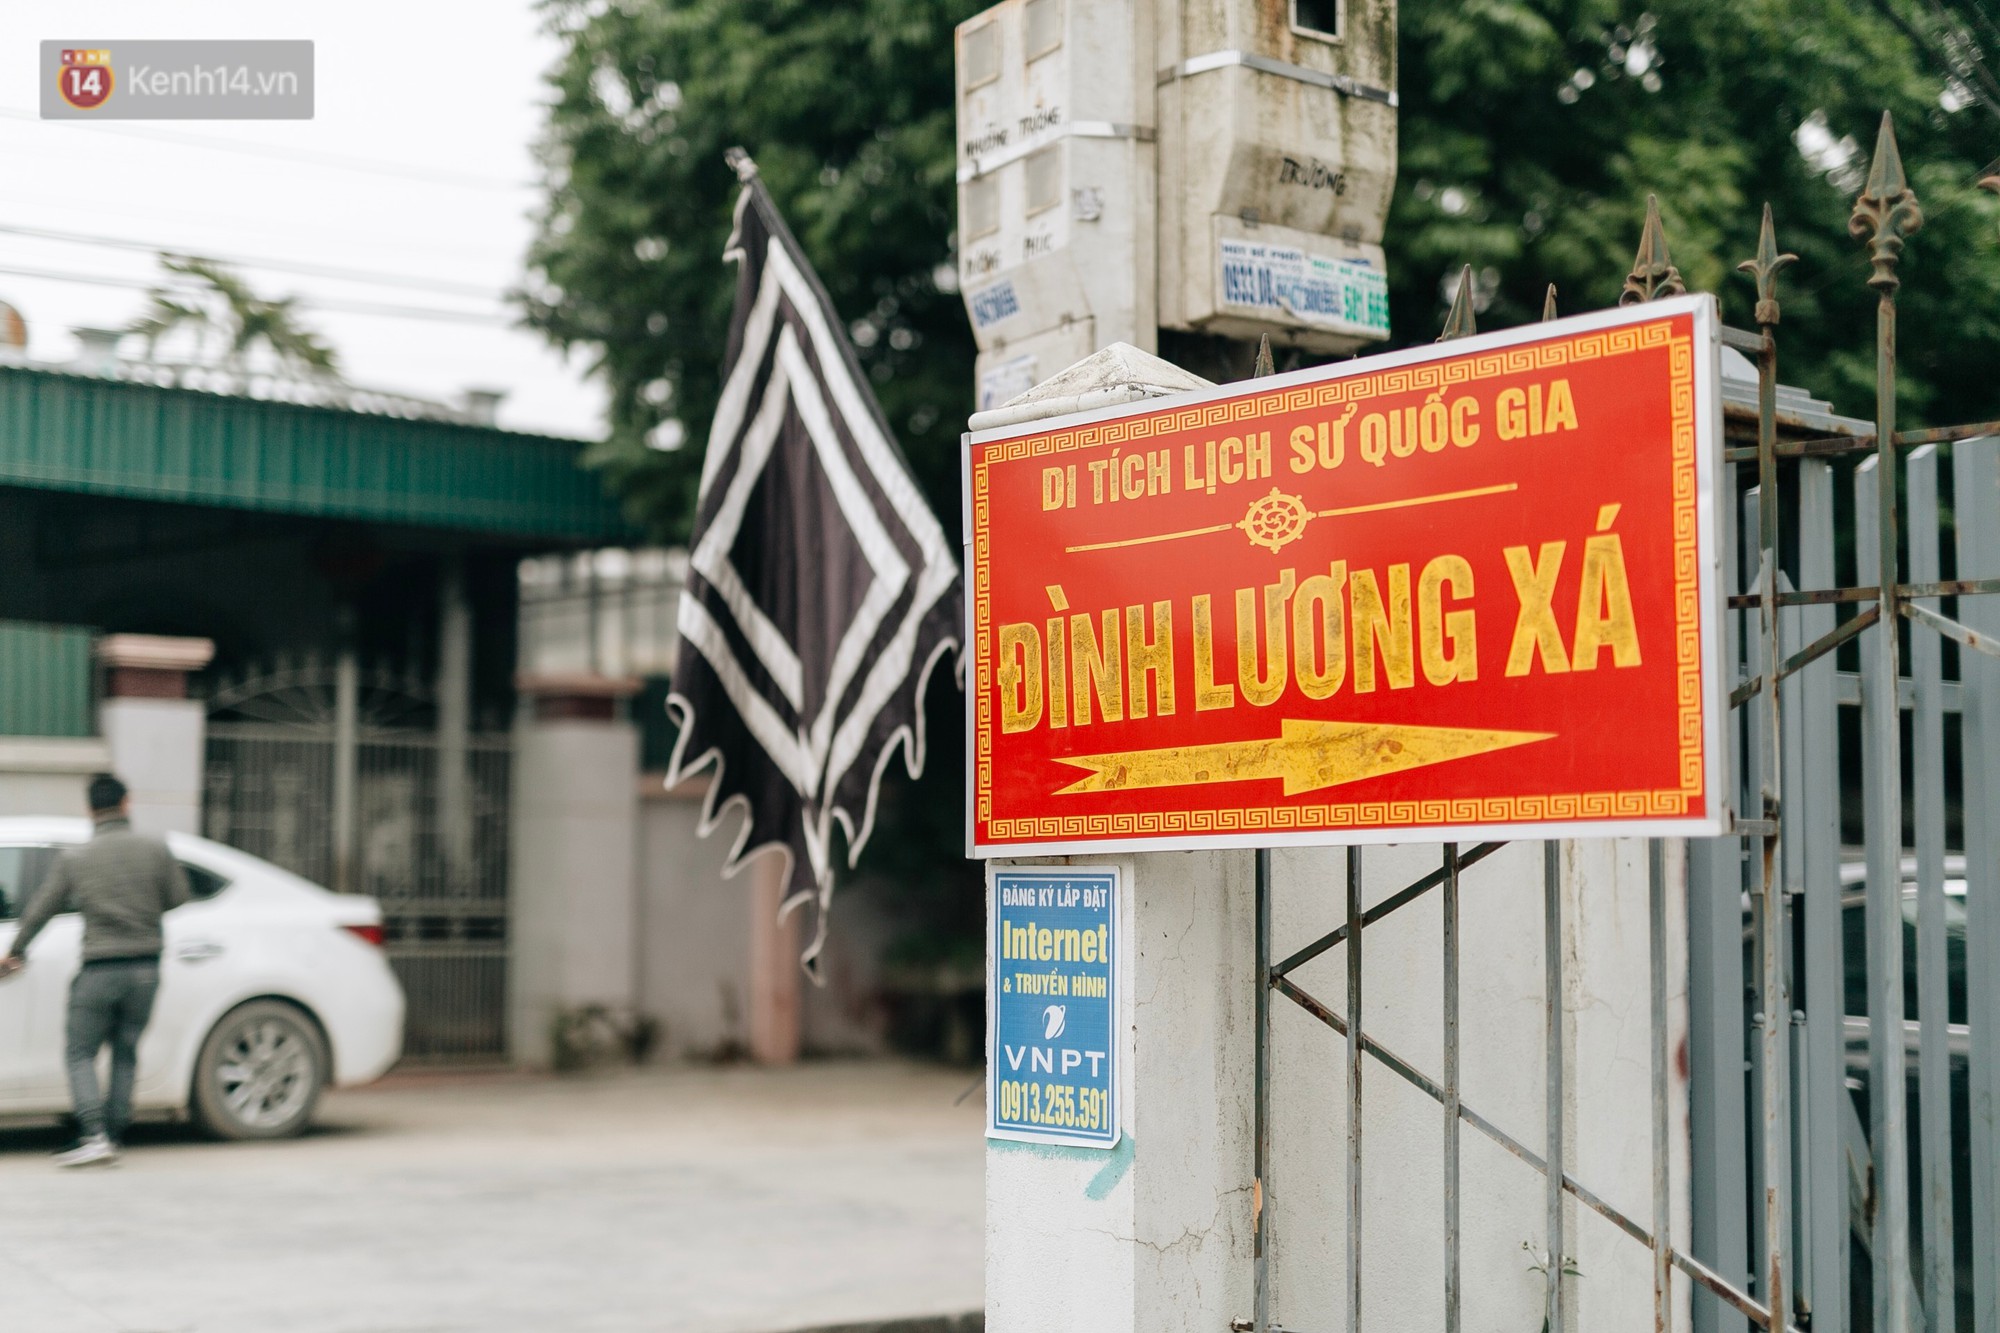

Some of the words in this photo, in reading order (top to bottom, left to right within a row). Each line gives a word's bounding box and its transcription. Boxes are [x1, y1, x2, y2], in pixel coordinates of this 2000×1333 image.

[1042, 465, 1077, 511] DI
[1088, 448, 1171, 505] TÍCH
[1184, 432, 1273, 495] LỊCH
[1289, 402, 1358, 474] SỬ
[1359, 386, 1480, 467] QUỐC
[1496, 379, 1579, 441] GIA
[997, 584, 1175, 734] ĐÌNH
[1192, 554, 1478, 711] LƯƠNG
[1503, 503, 1642, 677] XÁ
[1003, 884, 1036, 906] ĐĂNG
[1038, 884, 1055, 907] KÝ
[1057, 883, 1081, 907] LẮP
[1083, 885, 1107, 912] ĐẶT
[1003, 920, 1108, 964] Internet
[1003, 977, 1012, 993] &
[1015, 967, 1069, 996] TRUYỀN
[1072, 971, 1107, 998] HÌNH
[1004, 1044, 1106, 1078] VNPT
[1001, 1079, 1108, 1131] 0913.255.591
